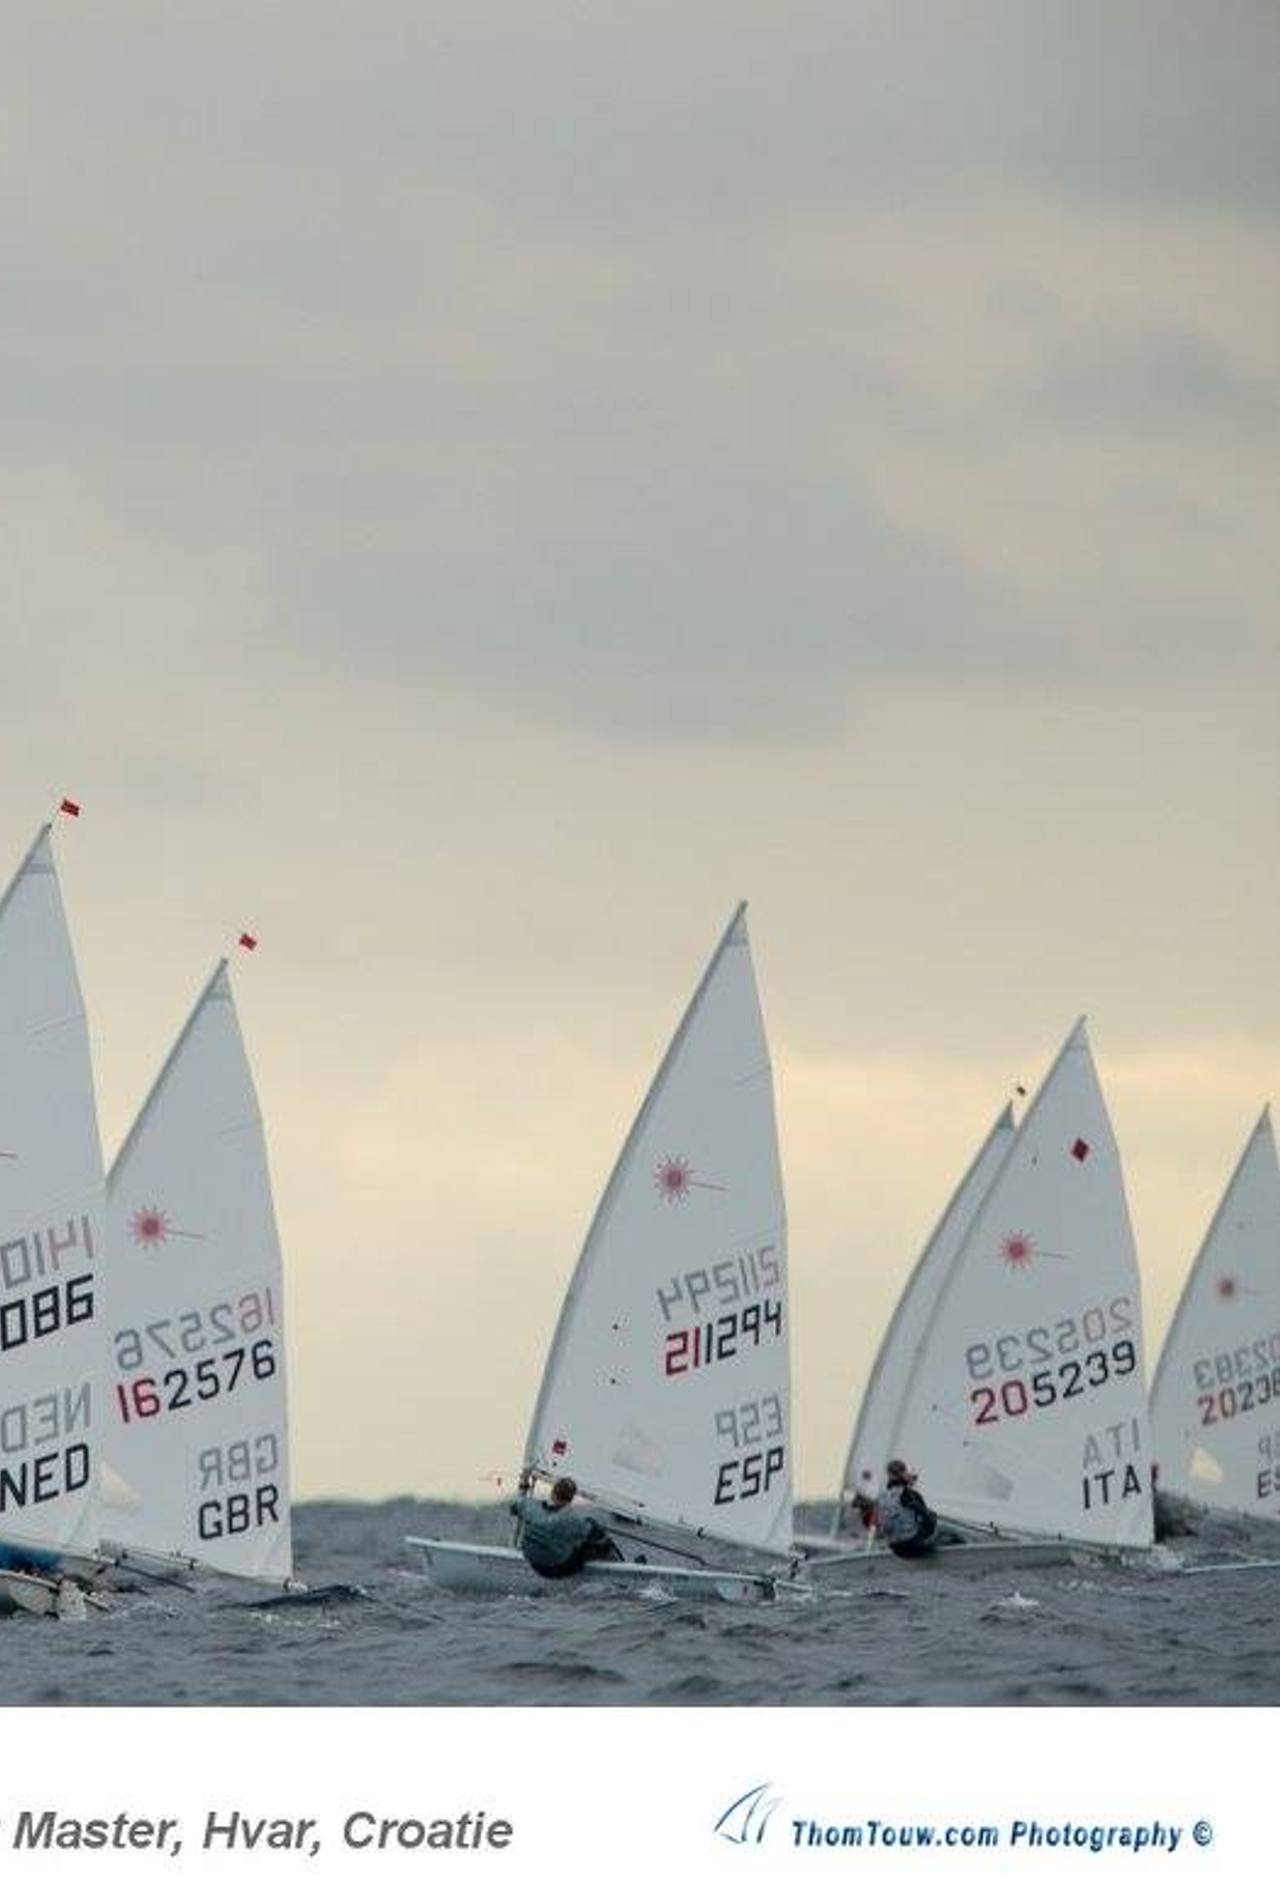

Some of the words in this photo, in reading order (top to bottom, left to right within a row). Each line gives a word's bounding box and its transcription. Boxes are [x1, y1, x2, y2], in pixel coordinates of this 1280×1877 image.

[665, 1300, 782, 1377] 211294
[117, 1339, 276, 1423] 162576
[970, 1340, 1137, 1425] 205239
[714, 1446, 785, 1505] ESP
[1083, 1465, 1142, 1510] ITA
[198, 1484, 279, 1540] GBR
